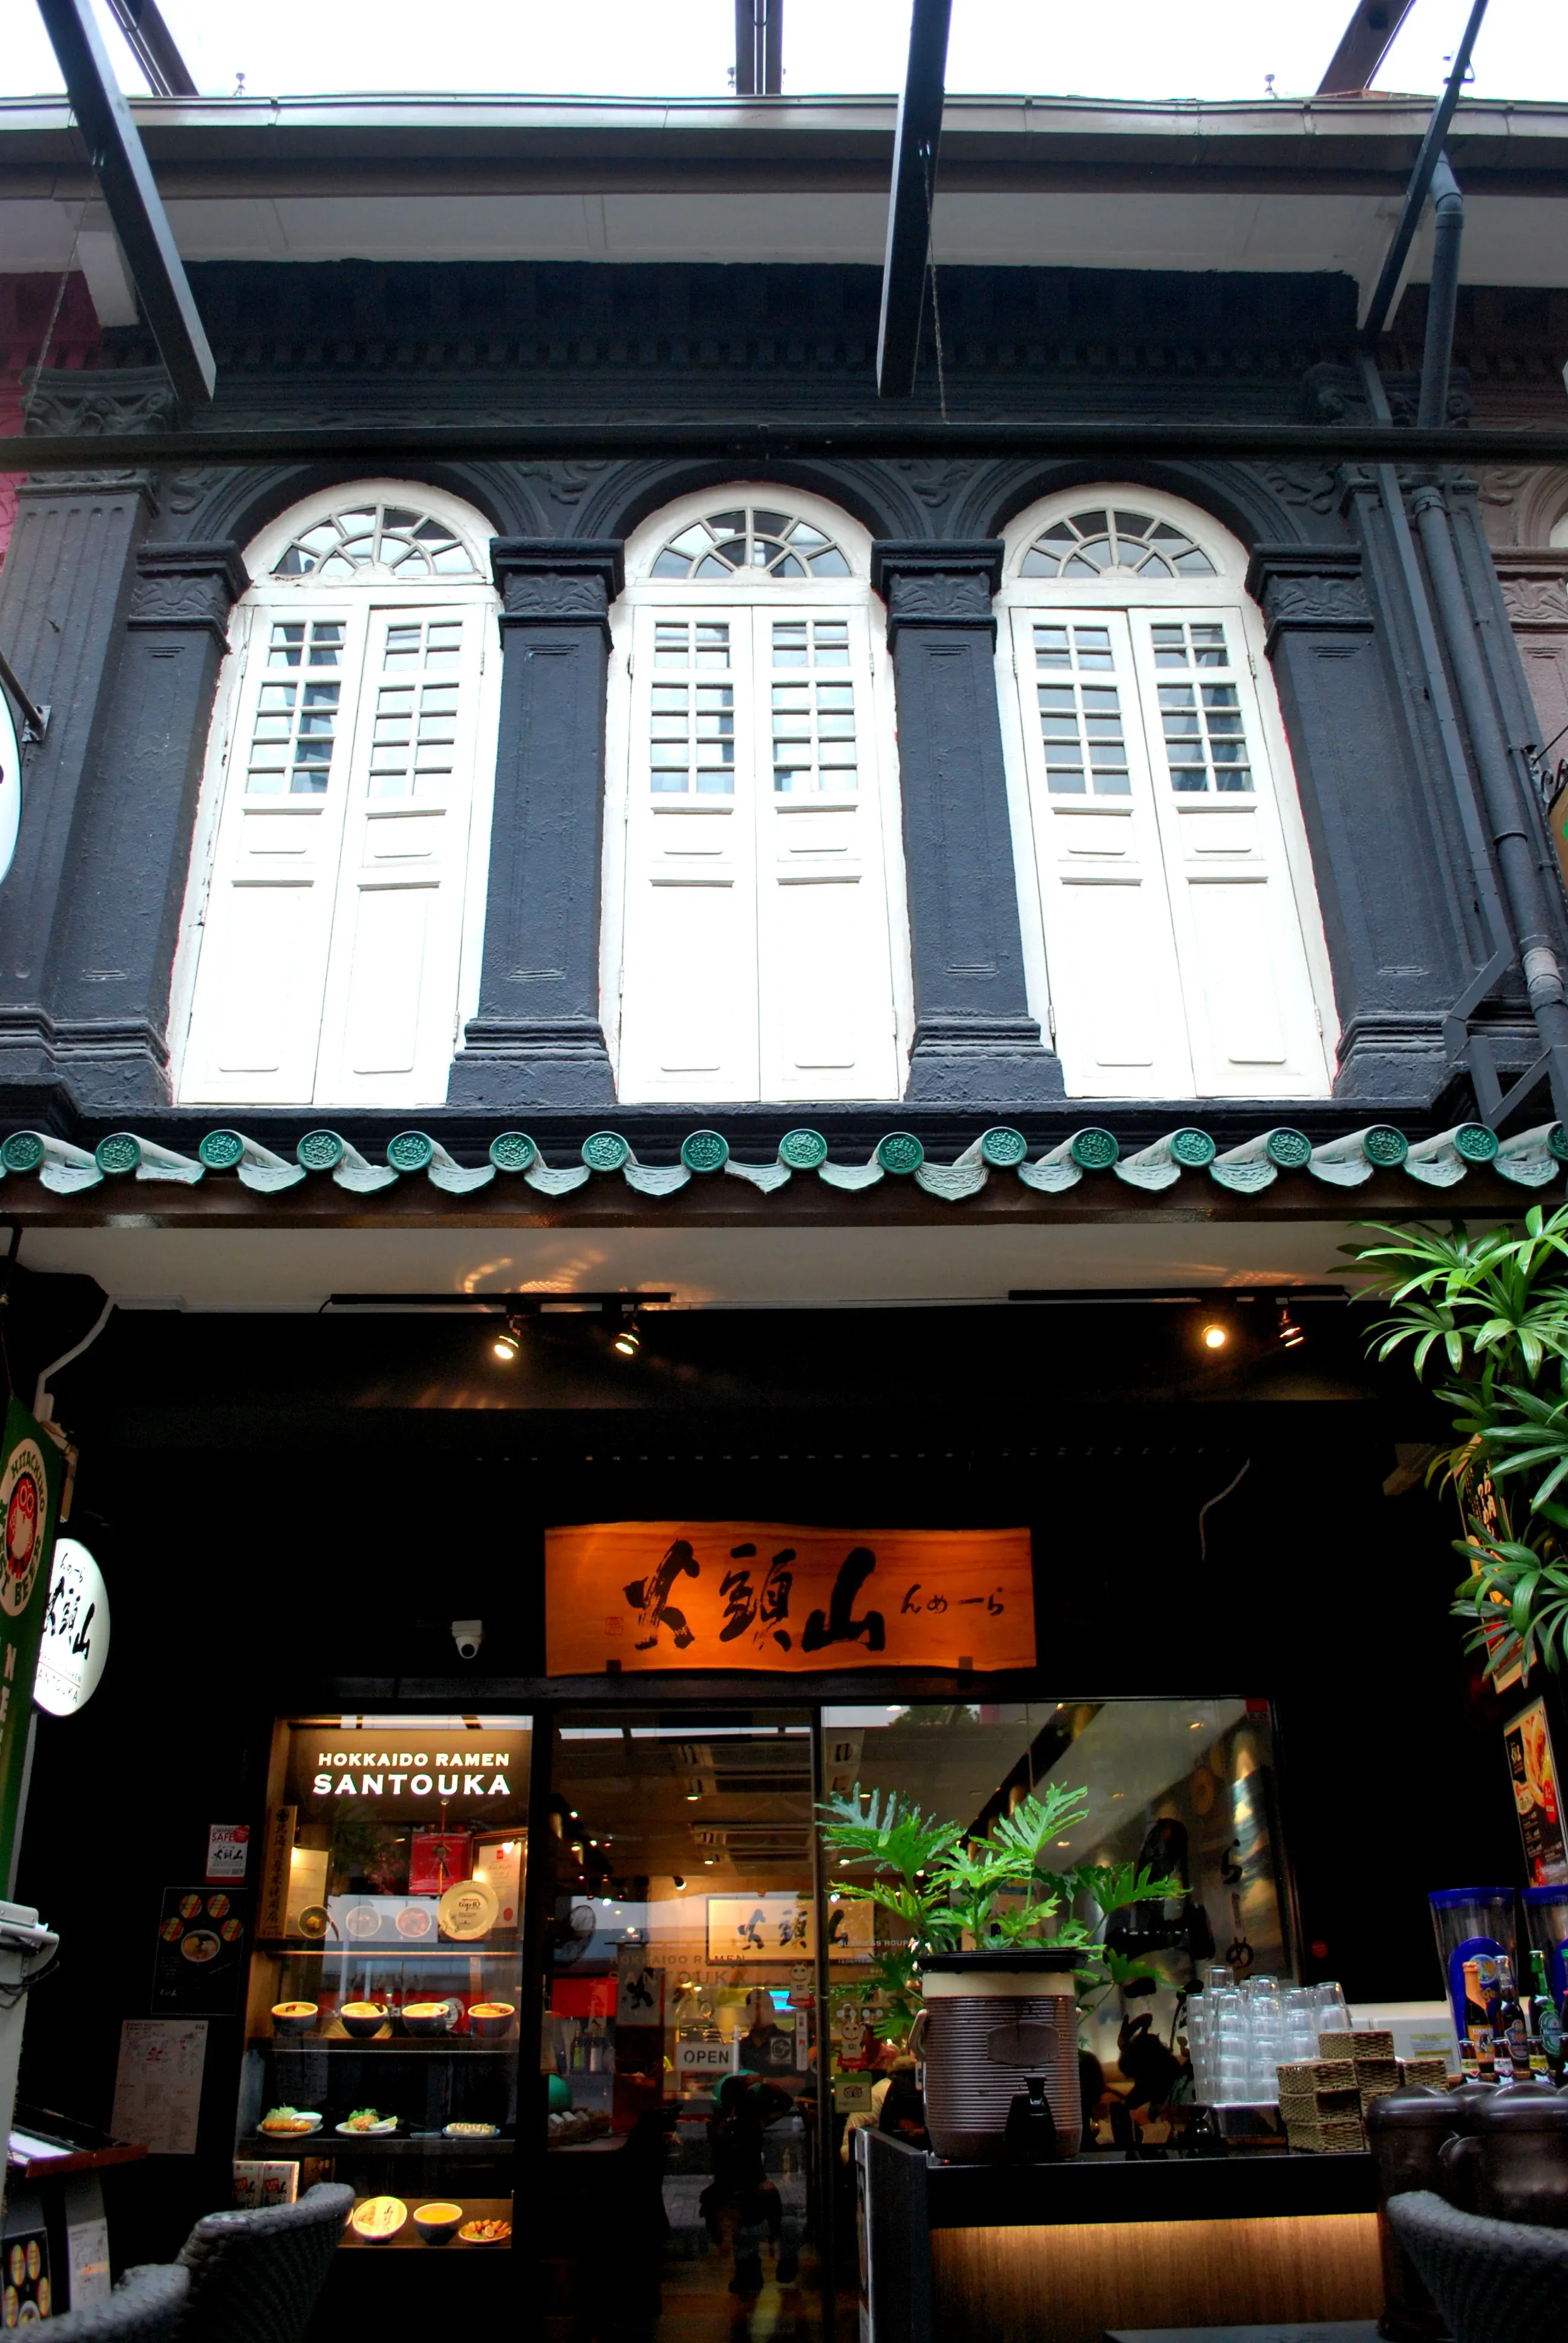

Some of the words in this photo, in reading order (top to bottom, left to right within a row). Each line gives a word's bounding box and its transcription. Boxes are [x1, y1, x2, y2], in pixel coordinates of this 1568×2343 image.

[318, 1752, 429, 1767] HOKKAIDO
[435, 1752, 510, 1767] RAMEN
[312, 1773, 511, 1795] SANTOUKA
[684, 2050, 730, 2064] OPEN
